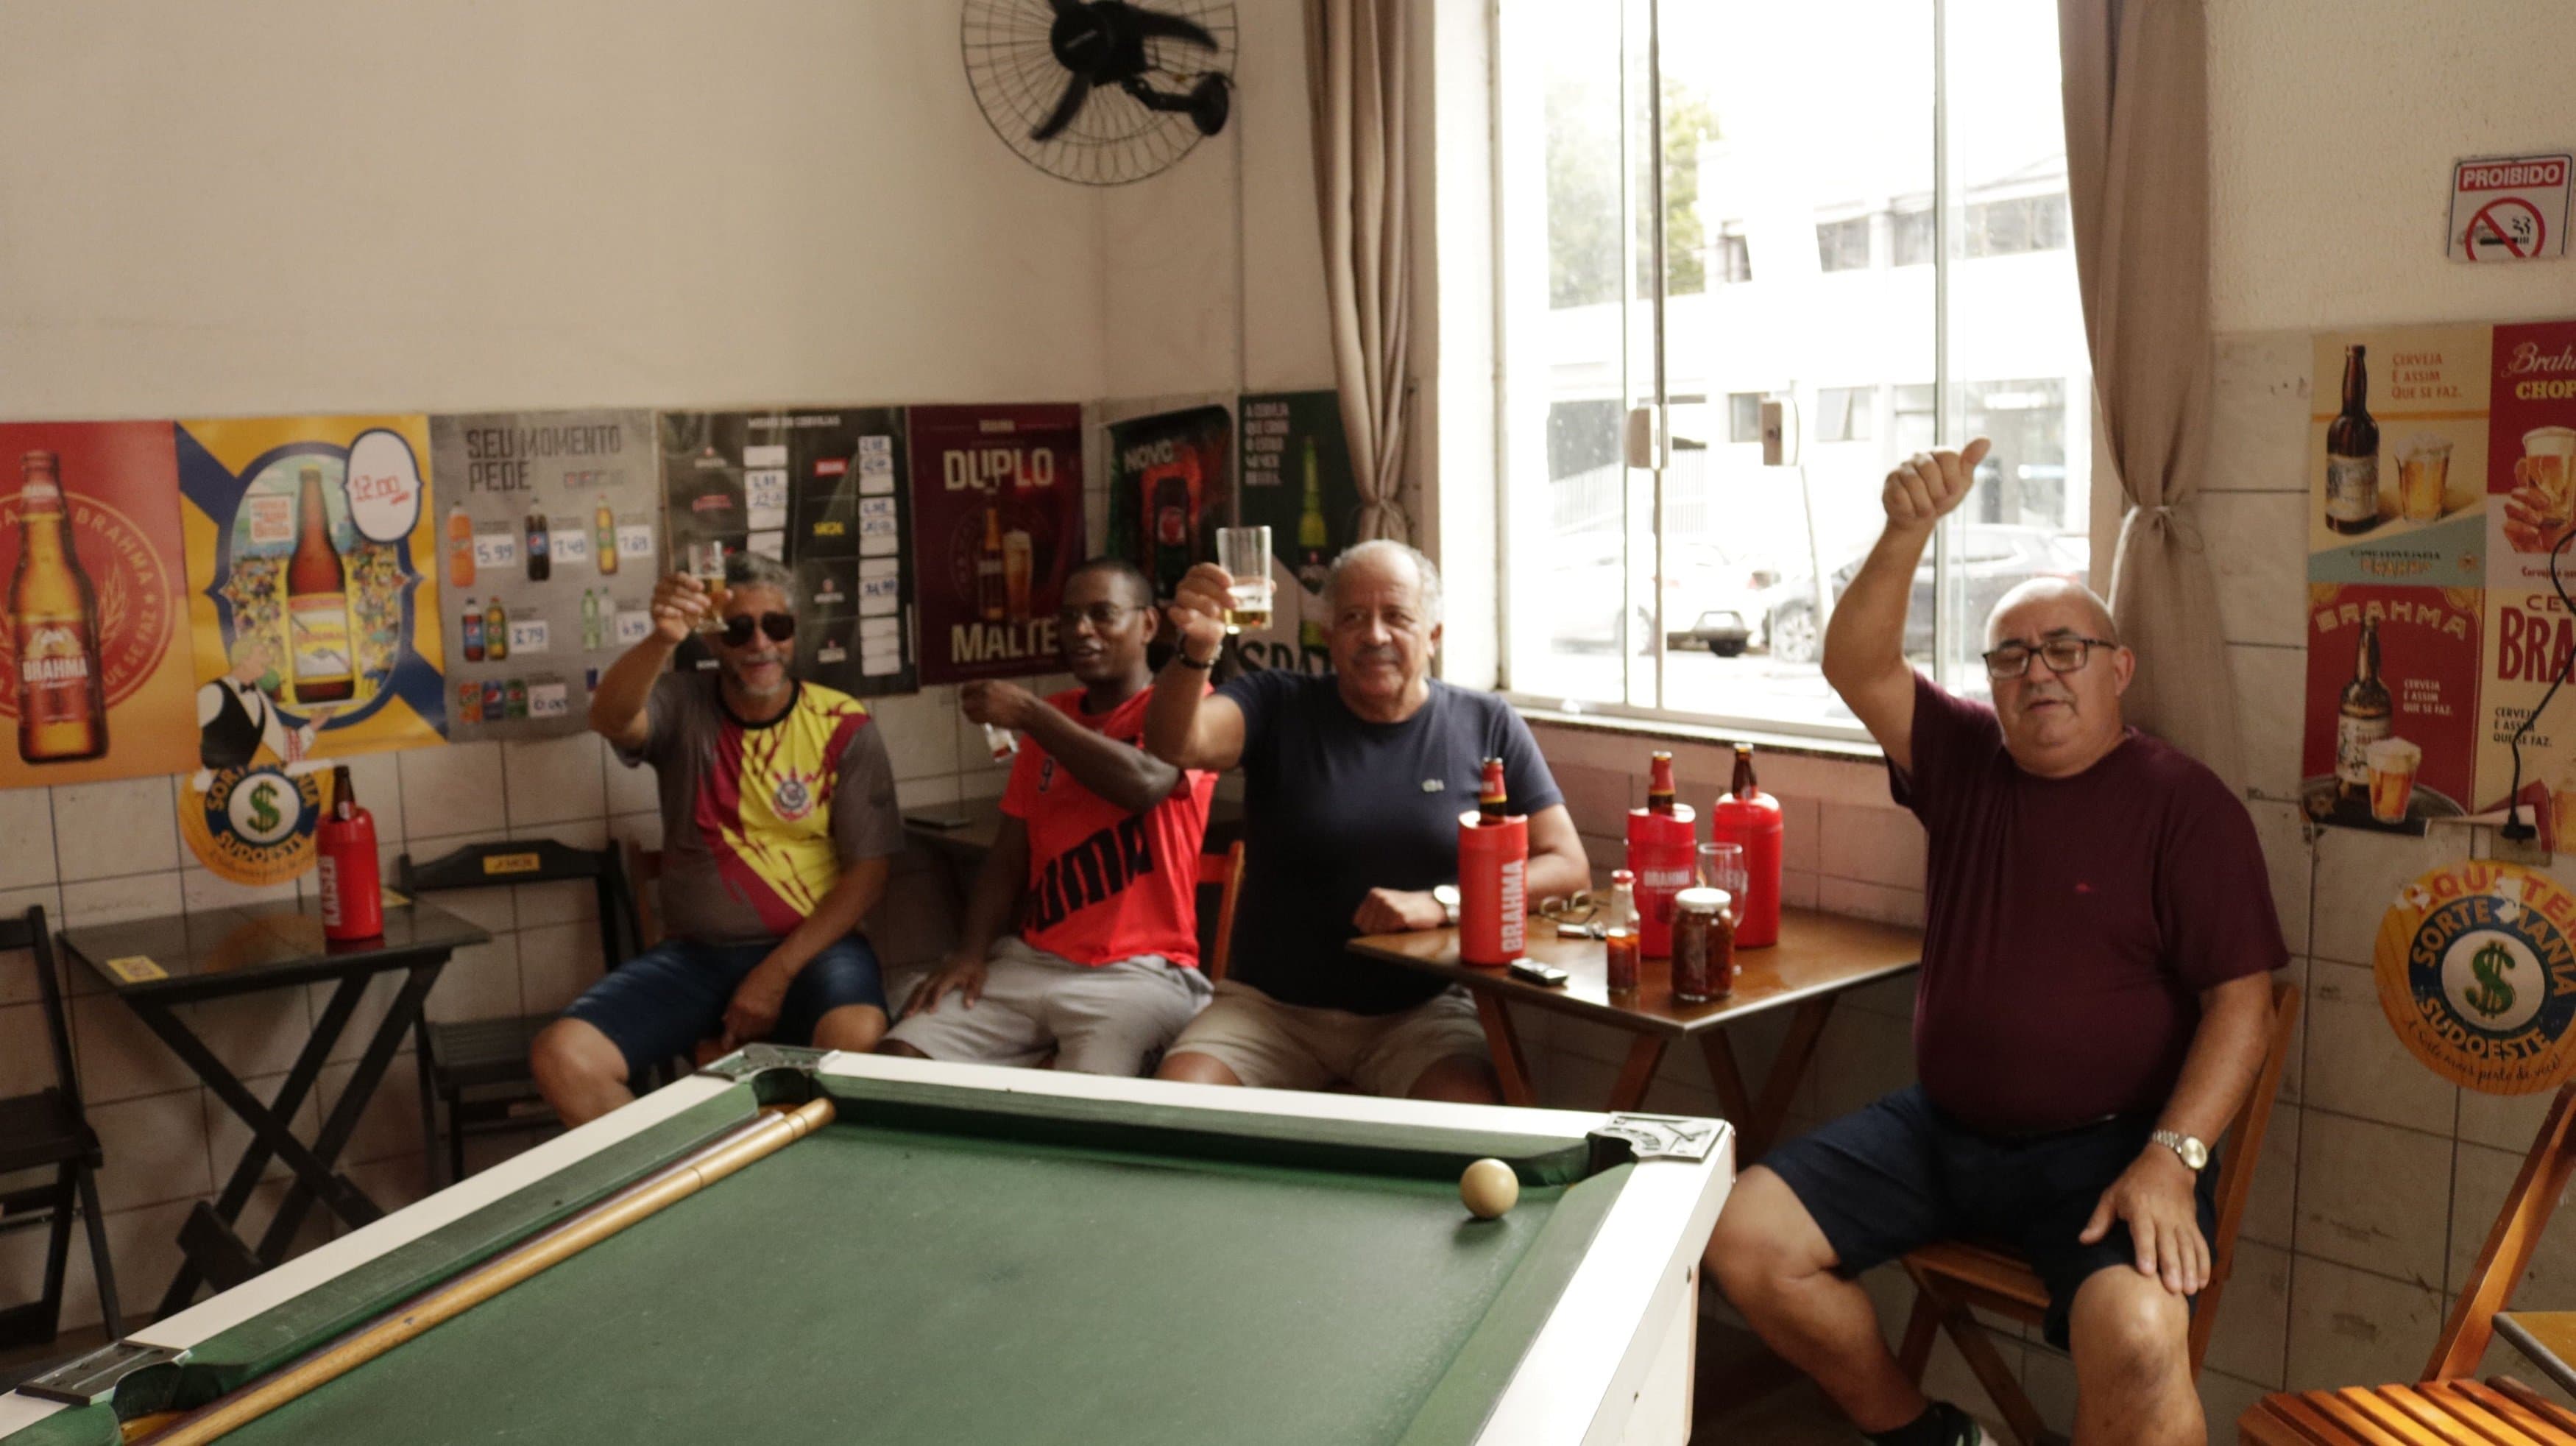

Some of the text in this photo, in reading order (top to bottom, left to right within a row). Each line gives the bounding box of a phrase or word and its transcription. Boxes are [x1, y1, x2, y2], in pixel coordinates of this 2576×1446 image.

[2463, 164, 2560, 188] PROIBIDO
[2393, 353, 2442, 366] CERVEJA
[2405, 370, 2440, 382] ASSIM
[2391, 386, 2414, 399] QUE
[467, 425, 622, 458] SEU MOMENTO
[1123, 439, 1175, 473] NOVO
[469, 461, 531, 492] PEDE
[943, 446, 1054, 492] DUPLO
[76, 507, 155, 585] BRAHMA
[2315, 599, 2468, 641] BRAHMA
[951, 616, 1060, 665] MALTE
[23, 657, 88, 682] BRAHMA
[2403, 678, 2440, 691] CERVEJA
[1643, 870, 1690, 887] BRAHMA
[1501, 859, 1524, 953] BRAHMA
[2413, 900, 2492, 968] SORTE
[2418, 995, 2552, 1061] SUDOESTE
